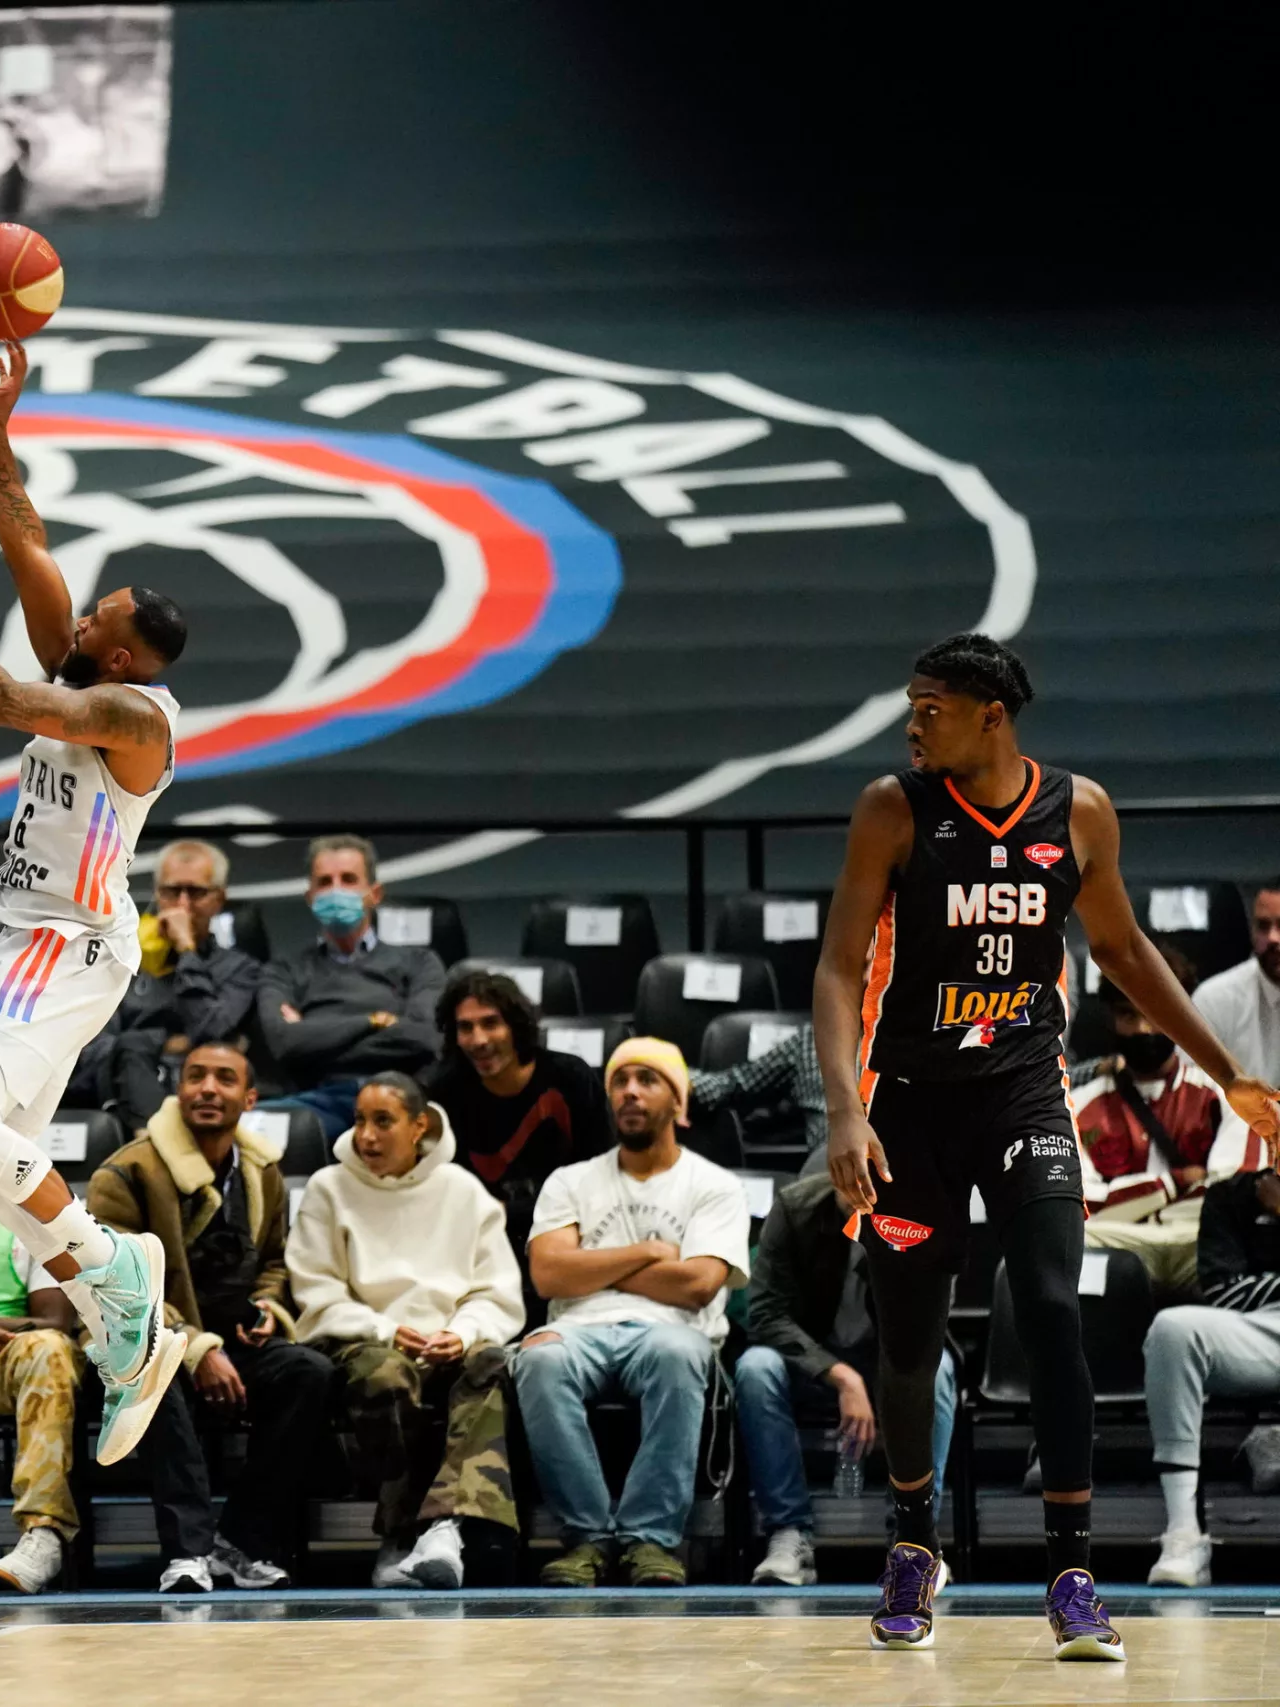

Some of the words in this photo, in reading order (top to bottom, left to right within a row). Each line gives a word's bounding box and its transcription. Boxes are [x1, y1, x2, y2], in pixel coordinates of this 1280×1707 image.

[23, 754, 77, 811] ARIS
[947, 882, 1047, 927] MSB
[84, 939, 101, 966] 6
[976, 933, 1013, 976] 39
[941, 981, 1031, 1026] Loué
[1031, 1145, 1071, 1157] Rapin
[15, 1160, 37, 1186] adidas
[879, 1218, 929, 1239] Gaulois
